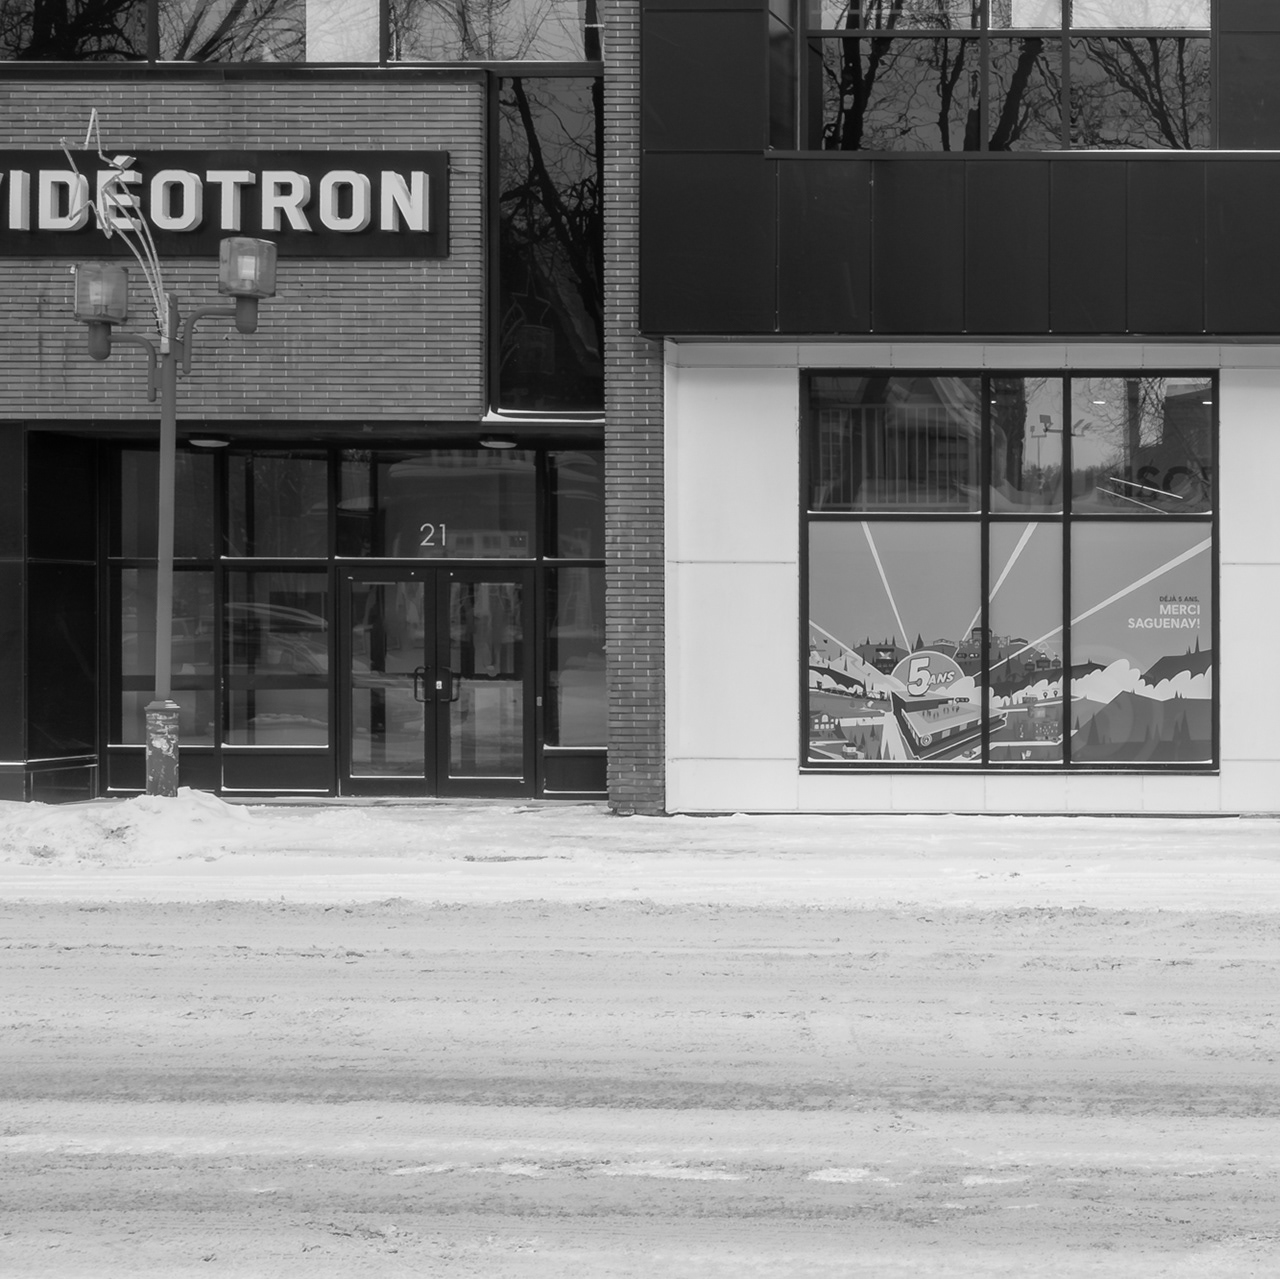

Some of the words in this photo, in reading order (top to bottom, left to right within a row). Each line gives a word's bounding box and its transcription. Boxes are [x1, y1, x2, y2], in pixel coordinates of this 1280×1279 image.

[0, 155, 429, 232] IDÉOTRON
[420, 523, 446, 546] 21
[1160, 604, 1200, 615] MERCI
[1128, 618, 1200, 629] SAGUENAY!
[907, 657, 931, 696] 5
[928, 671, 955, 686] ANS
